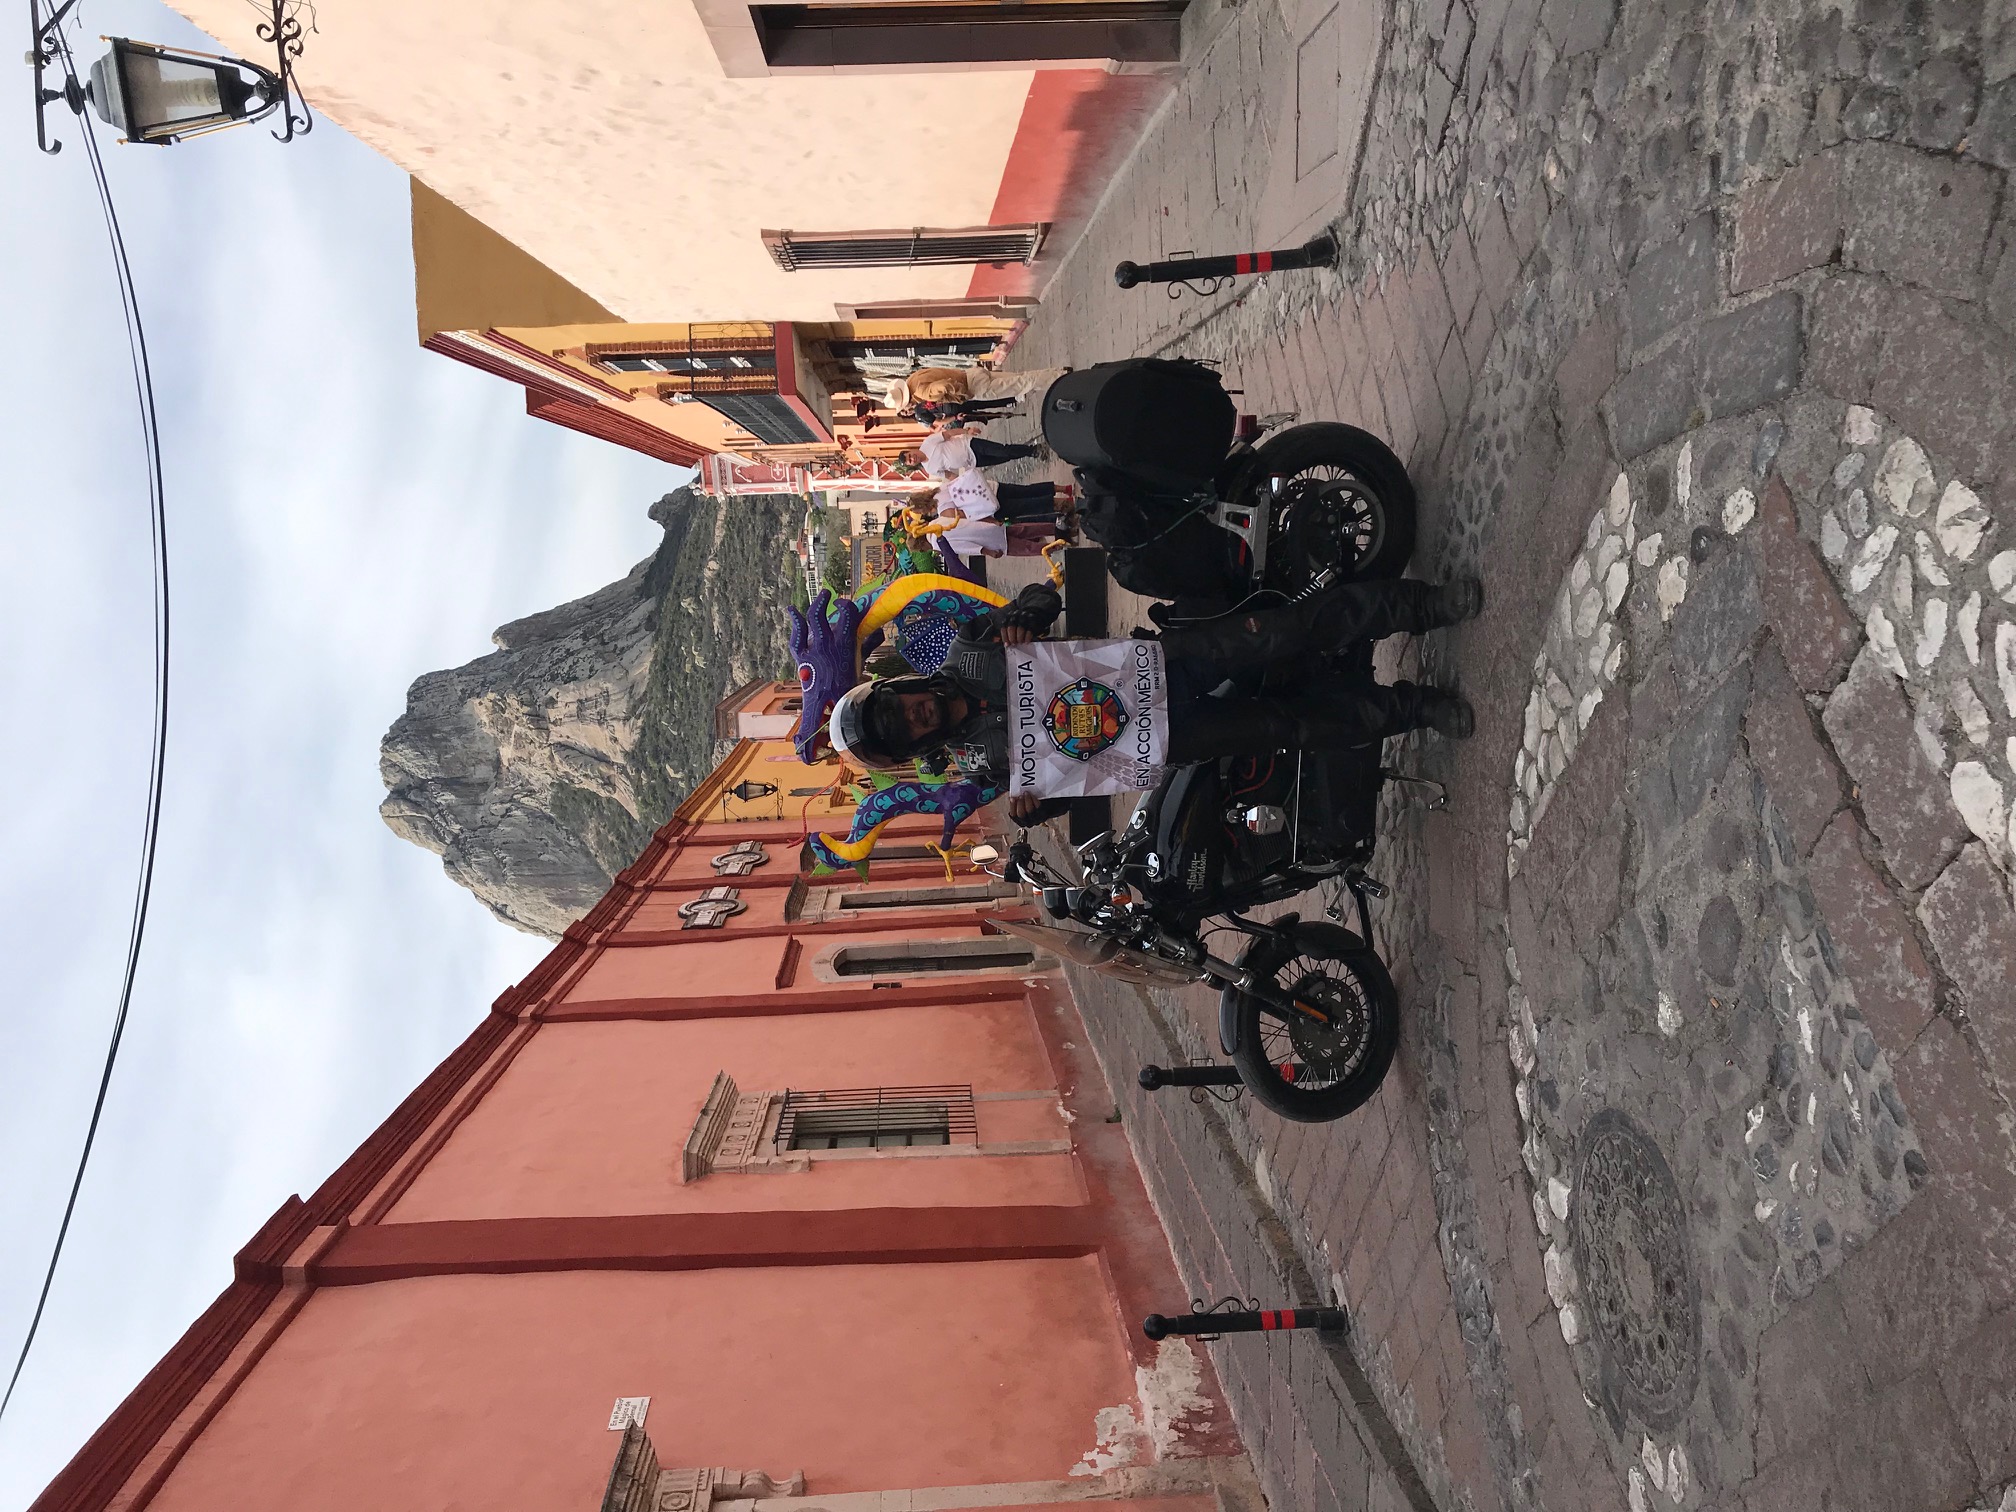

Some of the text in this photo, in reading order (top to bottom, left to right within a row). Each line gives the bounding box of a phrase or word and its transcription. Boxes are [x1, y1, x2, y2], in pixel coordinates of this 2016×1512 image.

[1018, 660, 1036, 787] MOTO TURISTA
[1046, 718, 1052, 726] N
[1119, 714, 1126, 722] S
[1134, 645, 1151, 787] EN ACCIÓN MÉXICO
[1187, 857, 1200, 888] Harley
[1195, 852, 1207, 889] Davidson
